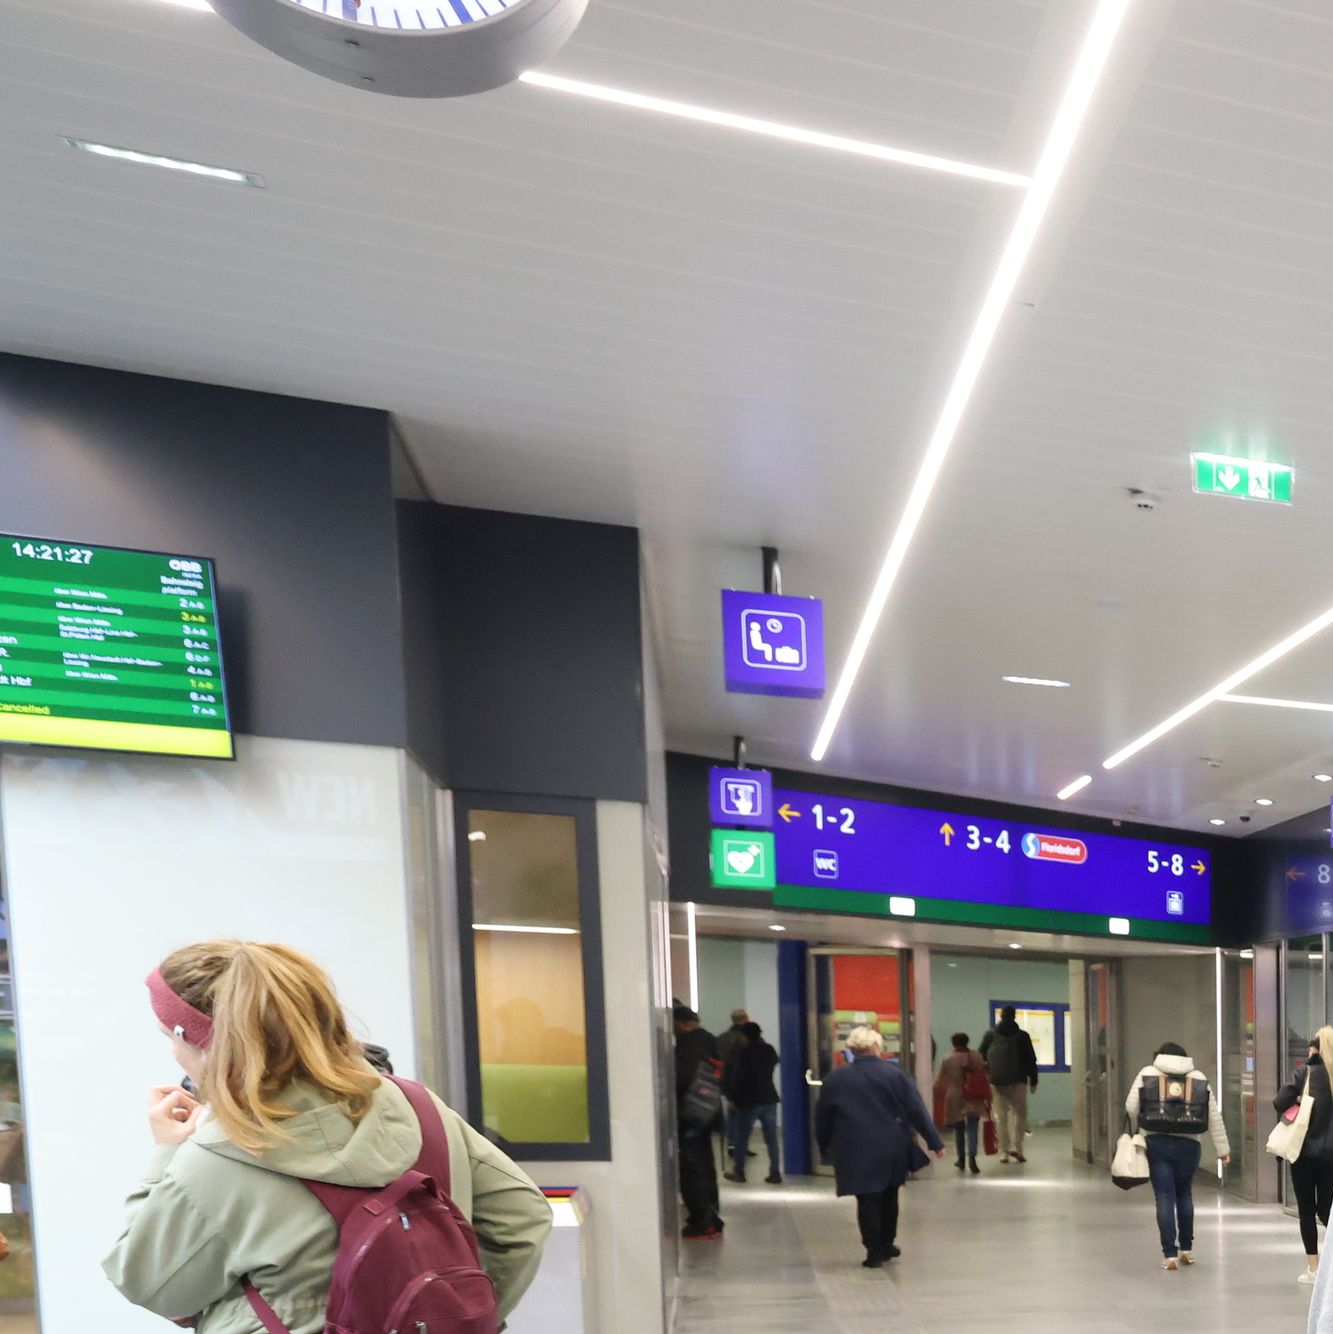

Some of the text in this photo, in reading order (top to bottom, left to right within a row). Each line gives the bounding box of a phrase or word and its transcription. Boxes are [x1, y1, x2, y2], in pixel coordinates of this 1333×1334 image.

[12, 541, 94, 565] 14:21:27
[811, 804, 856, 834] 1-2
[966, 825, 1011, 854] 3-4
[1041, 842, 1081, 856] Floridsdorf
[815, 857, 837, 871] WC
[1147, 850, 1184, 876] 5-8
